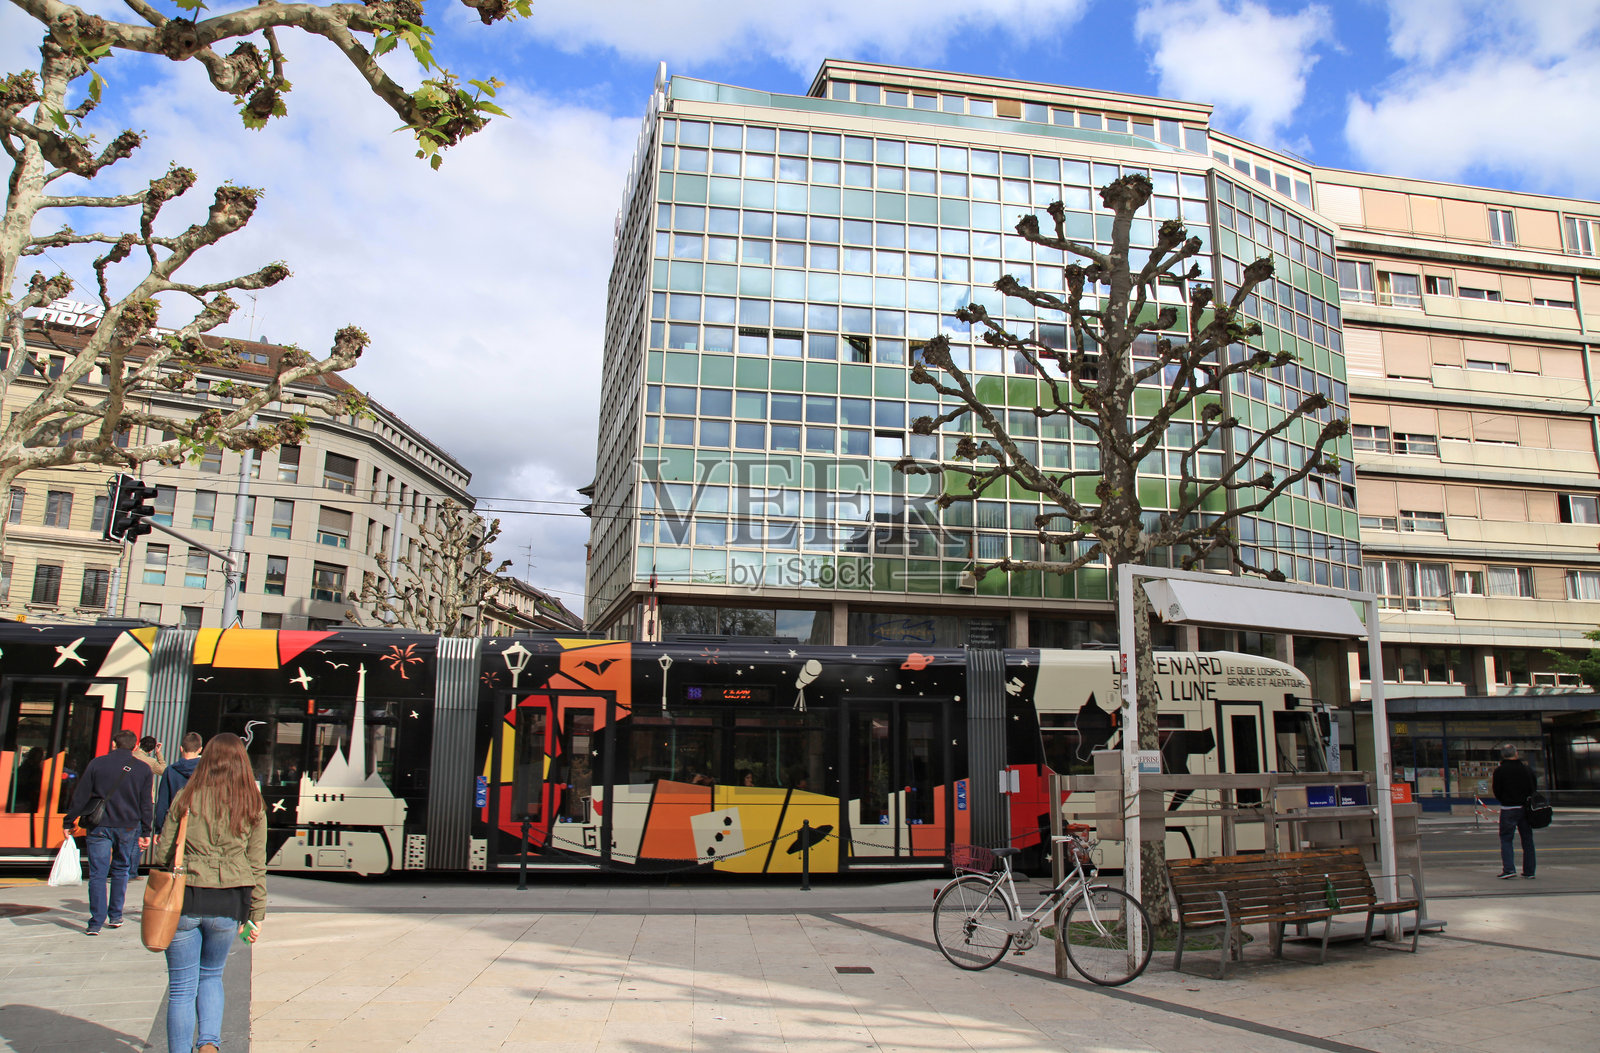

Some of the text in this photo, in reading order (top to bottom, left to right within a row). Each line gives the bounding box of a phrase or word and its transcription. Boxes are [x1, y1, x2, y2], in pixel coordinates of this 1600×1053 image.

[1226, 666, 1292, 677] LE GUIDE LOISIRS DE
[1227, 676, 1306, 689] GENÈVE ET ALENTOURS
[1171, 680, 1218, 701] LUNE
